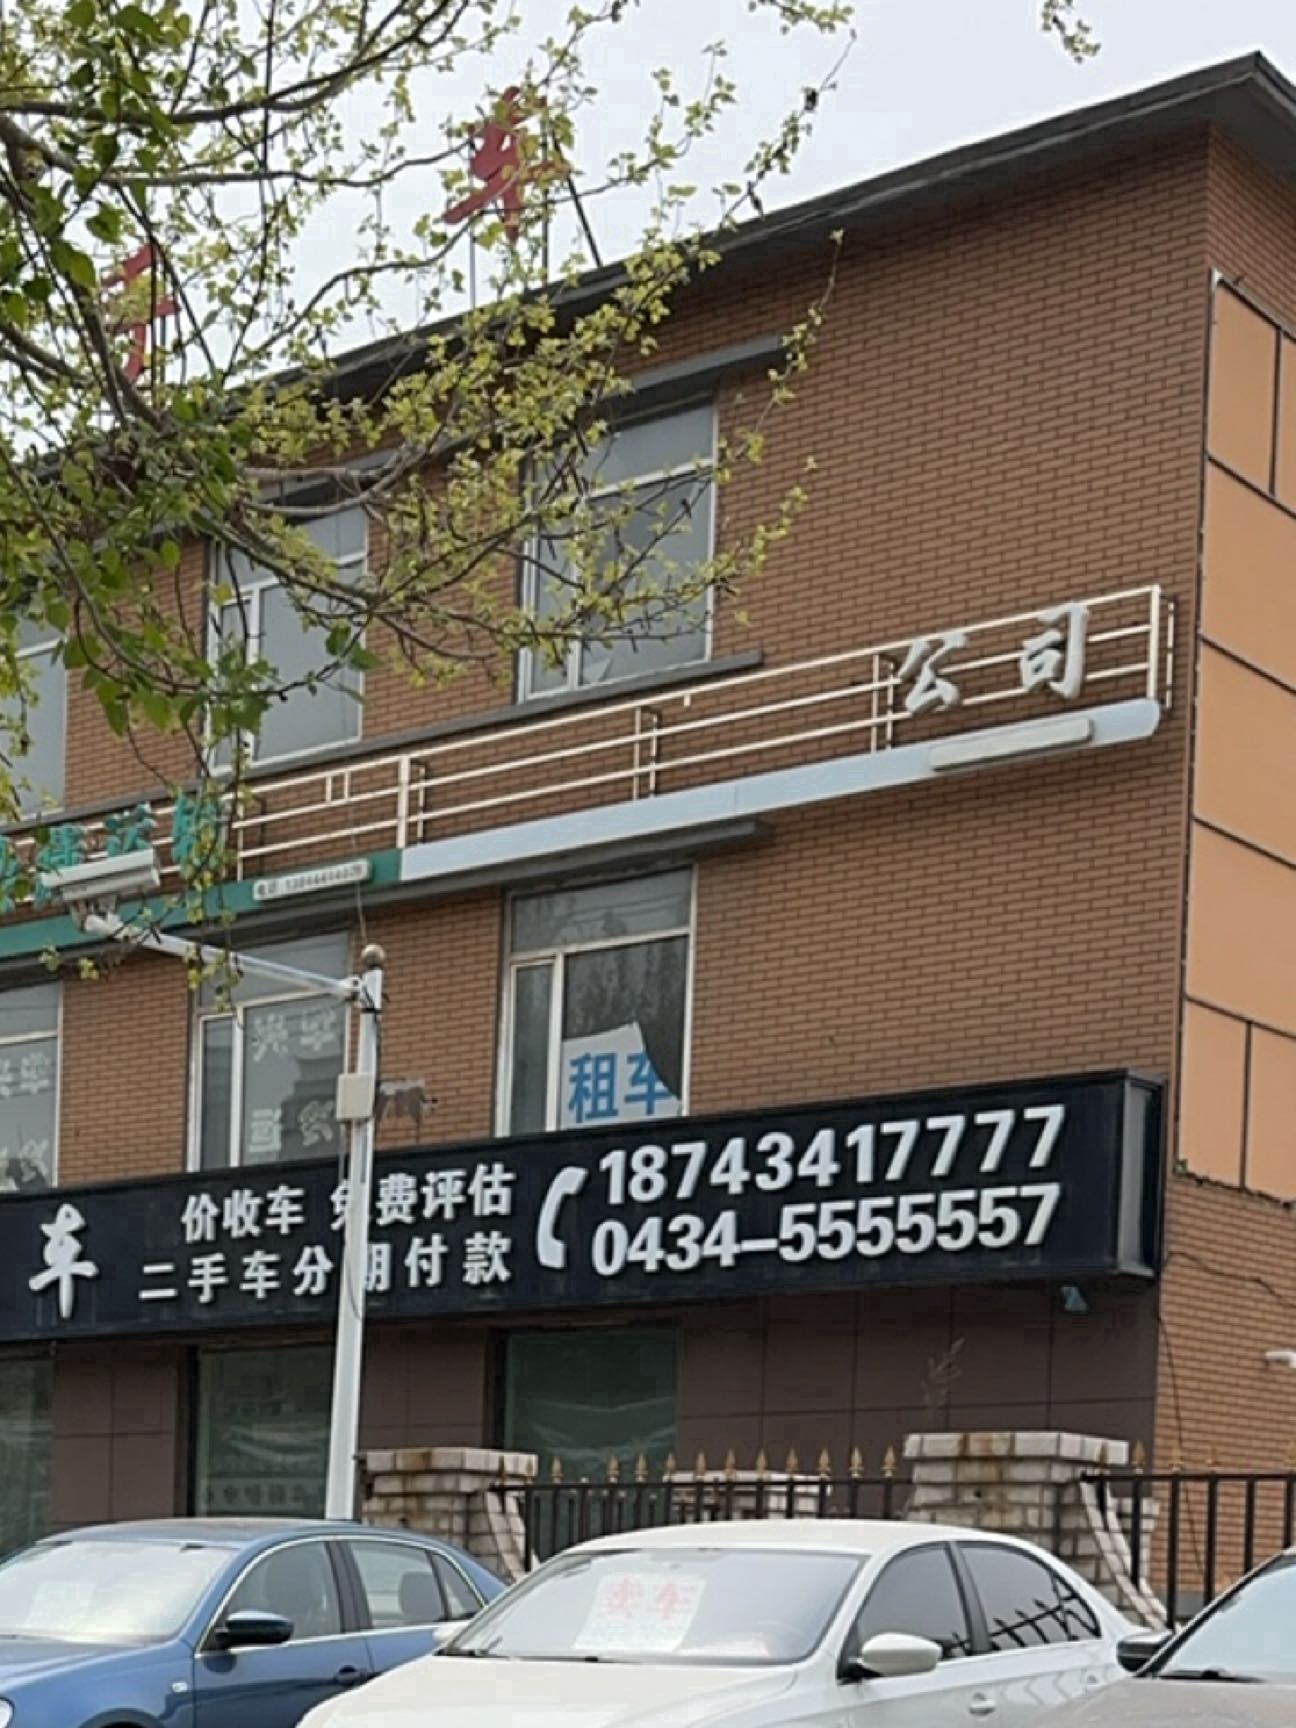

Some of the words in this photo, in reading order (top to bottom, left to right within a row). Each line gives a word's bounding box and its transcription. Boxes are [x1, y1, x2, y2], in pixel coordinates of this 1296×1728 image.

[897, 601, 1089, 713] 公司
[568, 1052, 674, 1123] 租车
[598, 1104, 1065, 1205] 18743417777
[181, 1184, 306, 1245] 价收车
[592, 1183, 1061, 1276] 0434-5555557
